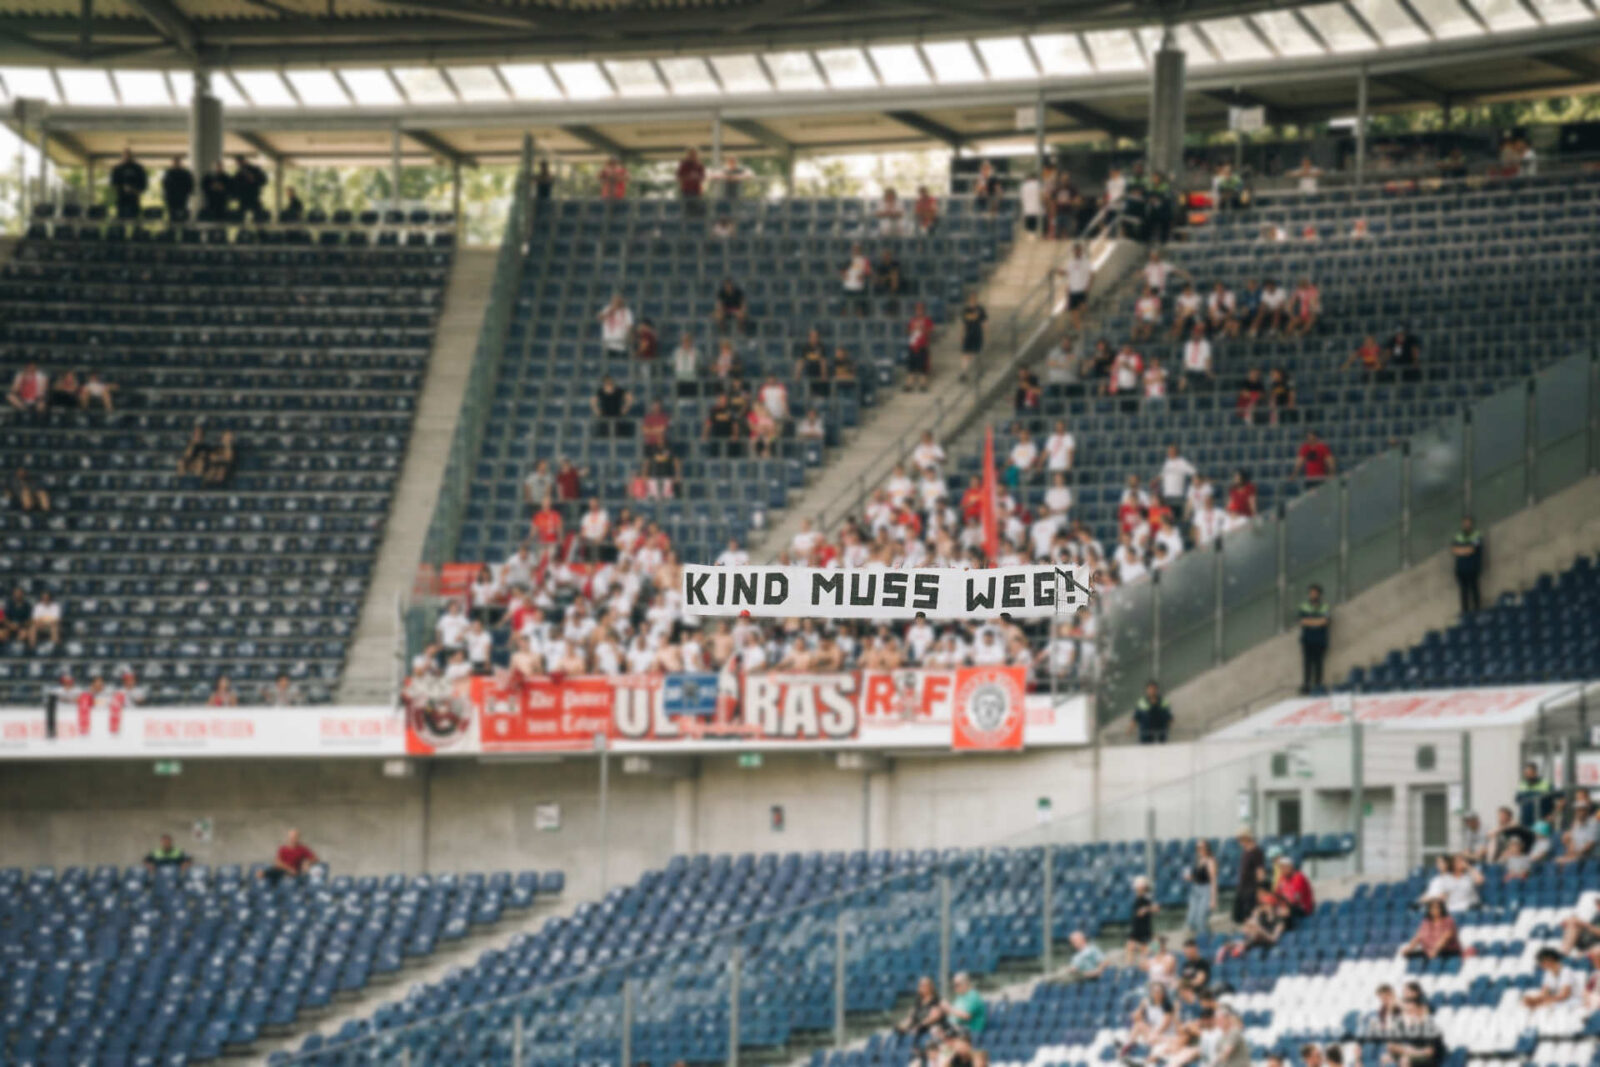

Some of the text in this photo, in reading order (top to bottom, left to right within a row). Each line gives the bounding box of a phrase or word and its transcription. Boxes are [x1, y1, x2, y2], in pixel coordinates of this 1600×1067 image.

[686, 570, 1076, 612] KIND MUSS WEG!
[613, 674, 857, 740] ULRAS
